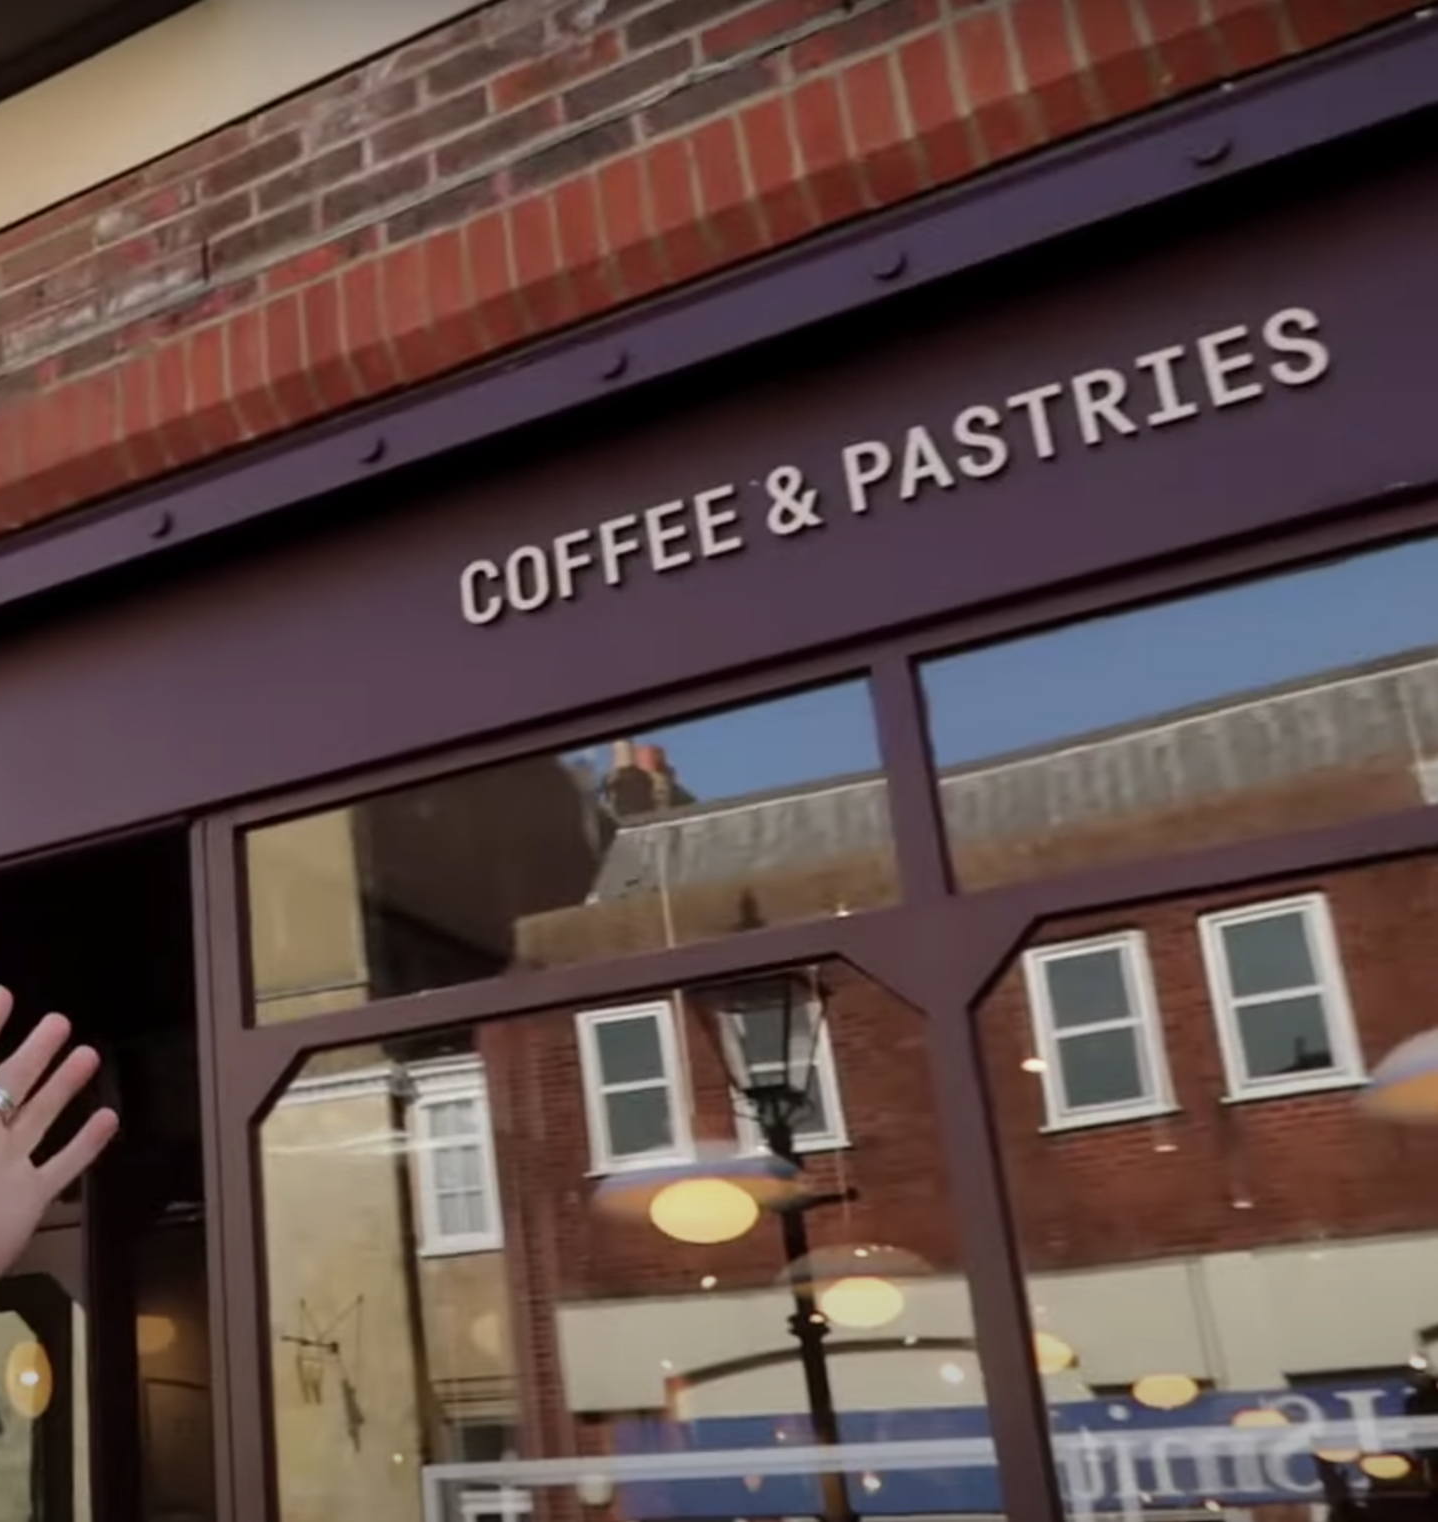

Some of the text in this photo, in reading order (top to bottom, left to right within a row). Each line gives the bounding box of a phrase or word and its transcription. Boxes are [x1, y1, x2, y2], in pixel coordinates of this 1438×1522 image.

[459, 307, 1330, 625] COFFEE & PASTRIES
